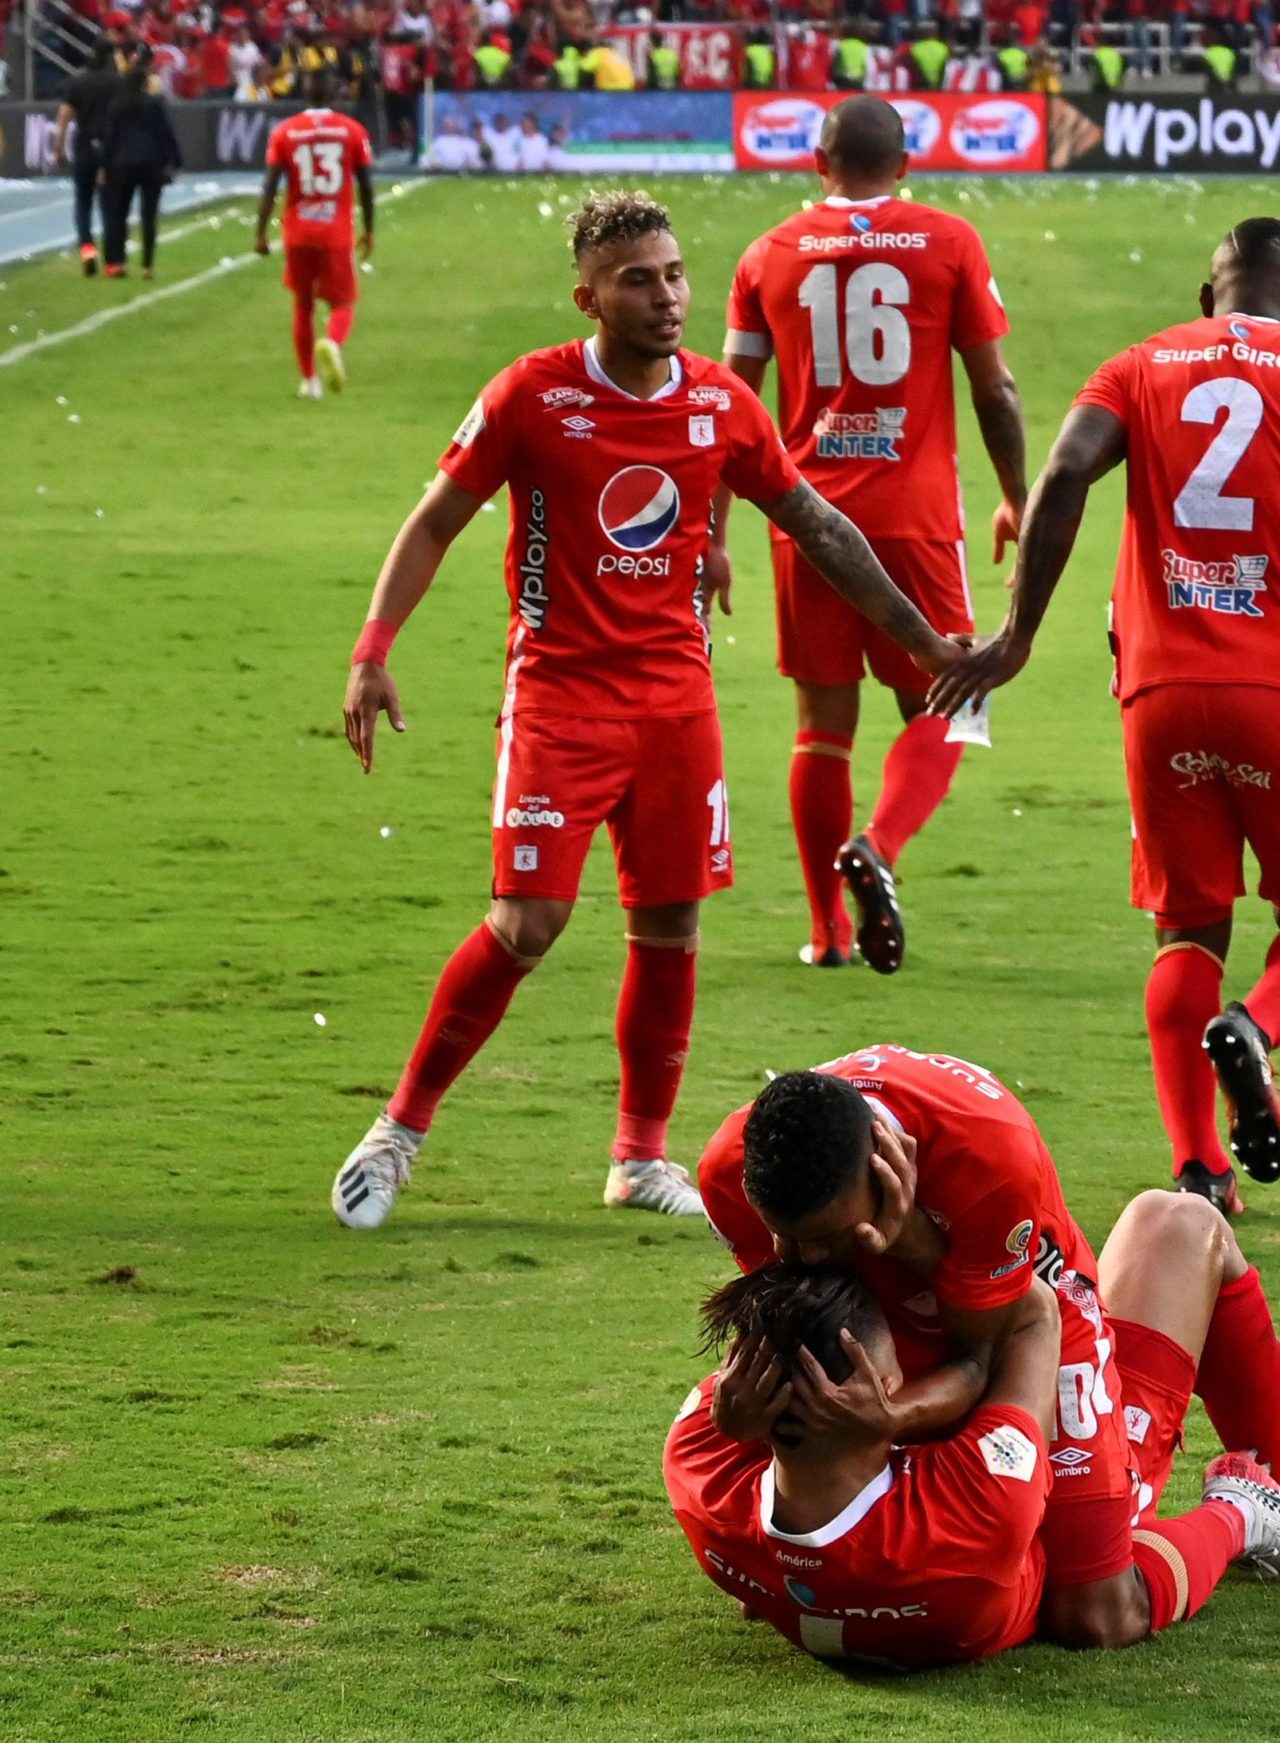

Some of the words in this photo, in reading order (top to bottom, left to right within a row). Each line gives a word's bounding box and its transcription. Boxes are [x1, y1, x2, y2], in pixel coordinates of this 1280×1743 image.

[292, 142, 344, 196] 13
[798, 262, 911, 388] 16
[817, 434, 901, 461] INTER
[1173, 376, 1264, 532] 2
[596, 554, 670, 579] pepsi
[1161, 549, 1237, 588] Super
[1168, 582, 1265, 617] INTER
[1050, 1362, 1098, 1441] 0
[1055, 1465, 1091, 1477] umbro
[775, 1549, 823, 1567] América
